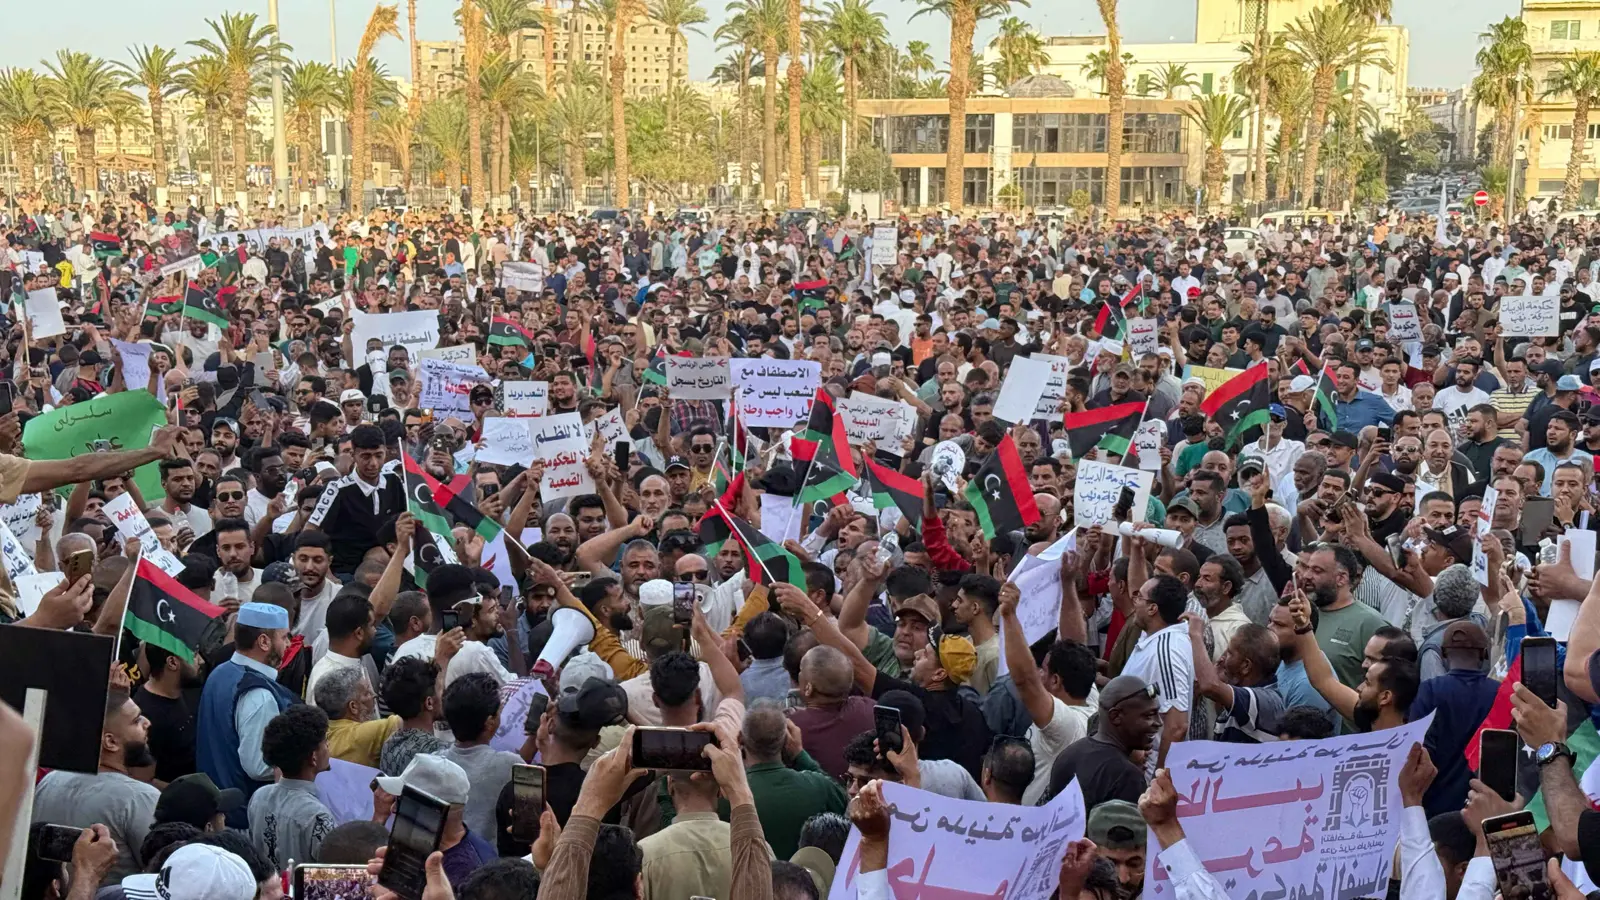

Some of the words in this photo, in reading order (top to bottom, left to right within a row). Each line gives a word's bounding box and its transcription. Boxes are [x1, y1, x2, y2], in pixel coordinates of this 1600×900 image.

[1393, 320, 1417, 332] حكومة
[399, 330, 432, 345] البعثة
[1131, 335, 1154, 346] حكومة
[740, 366, 755, 380] مع
[756, 366, 810, 378] الاصطفاف
[671, 376, 696, 388] يسجل
[697, 375, 727, 389] التاريخ
[508, 389, 523, 401] يريد
[524, 387, 546, 400] الشعب
[758, 386, 782, 400] ليس
[764, 404, 793, 419] واجب
[852, 414, 881, 428] الدبيبة
[535, 425, 571, 448] للظلم
[572, 422, 581, 437] لا
[548, 472, 584, 492] القمعية
[1105, 469, 1141, 490] حكومة
